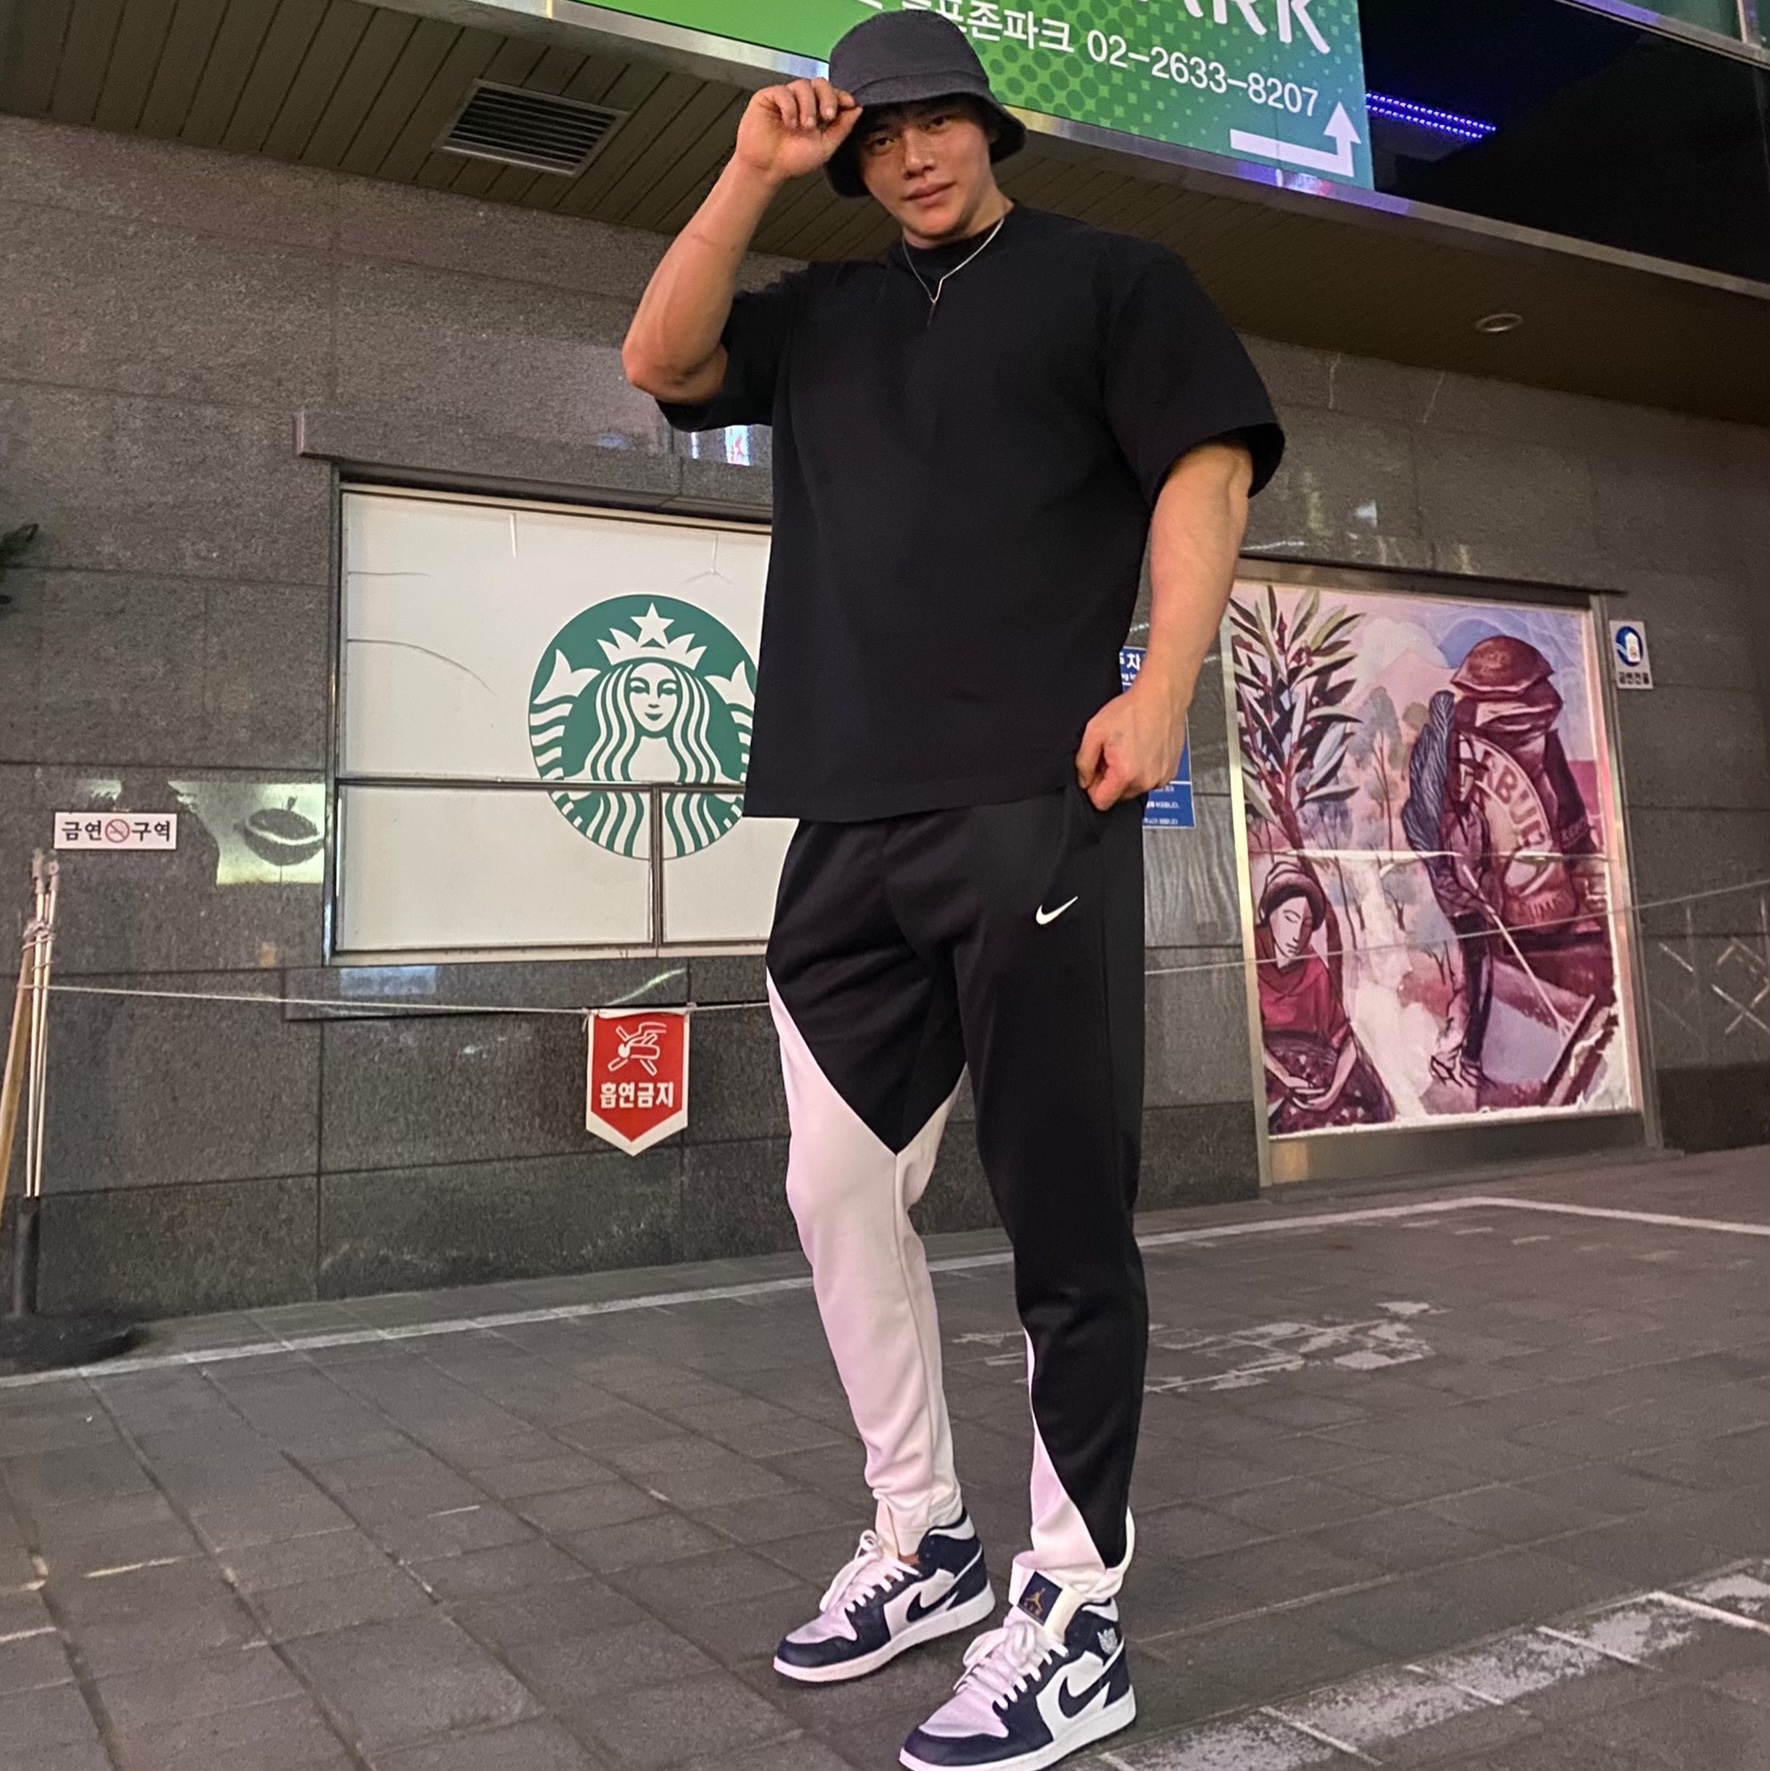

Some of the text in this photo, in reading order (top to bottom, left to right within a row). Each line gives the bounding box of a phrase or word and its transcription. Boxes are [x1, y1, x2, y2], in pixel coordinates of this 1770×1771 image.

[1087, 29, 1319, 118] 02-2633-8207
[61, 819, 172, 843] 금연 구역
[599, 1081, 674, 1109] 흡연금지
